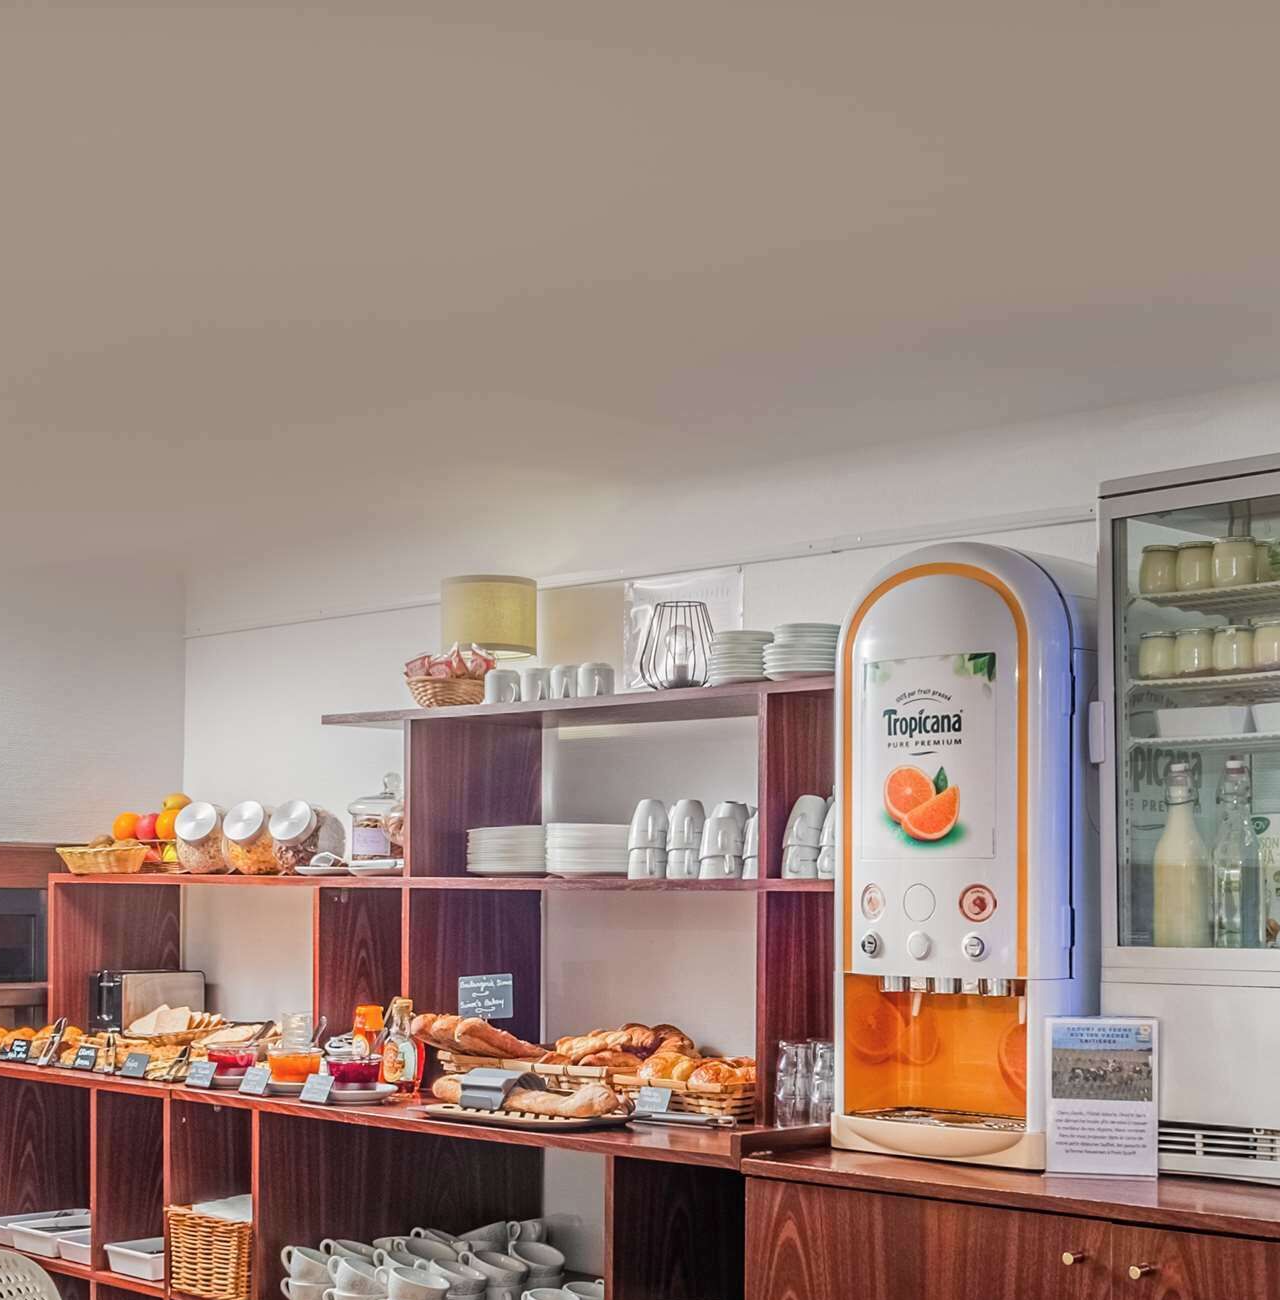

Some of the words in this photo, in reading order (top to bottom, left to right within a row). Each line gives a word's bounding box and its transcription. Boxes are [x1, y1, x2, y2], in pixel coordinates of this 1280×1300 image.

[917, 688, 931, 696] fruit
[883, 709, 962, 738] Tropicana
[887, 741, 910, 749] PURE
[915, 738, 962, 747] PREMIUM
